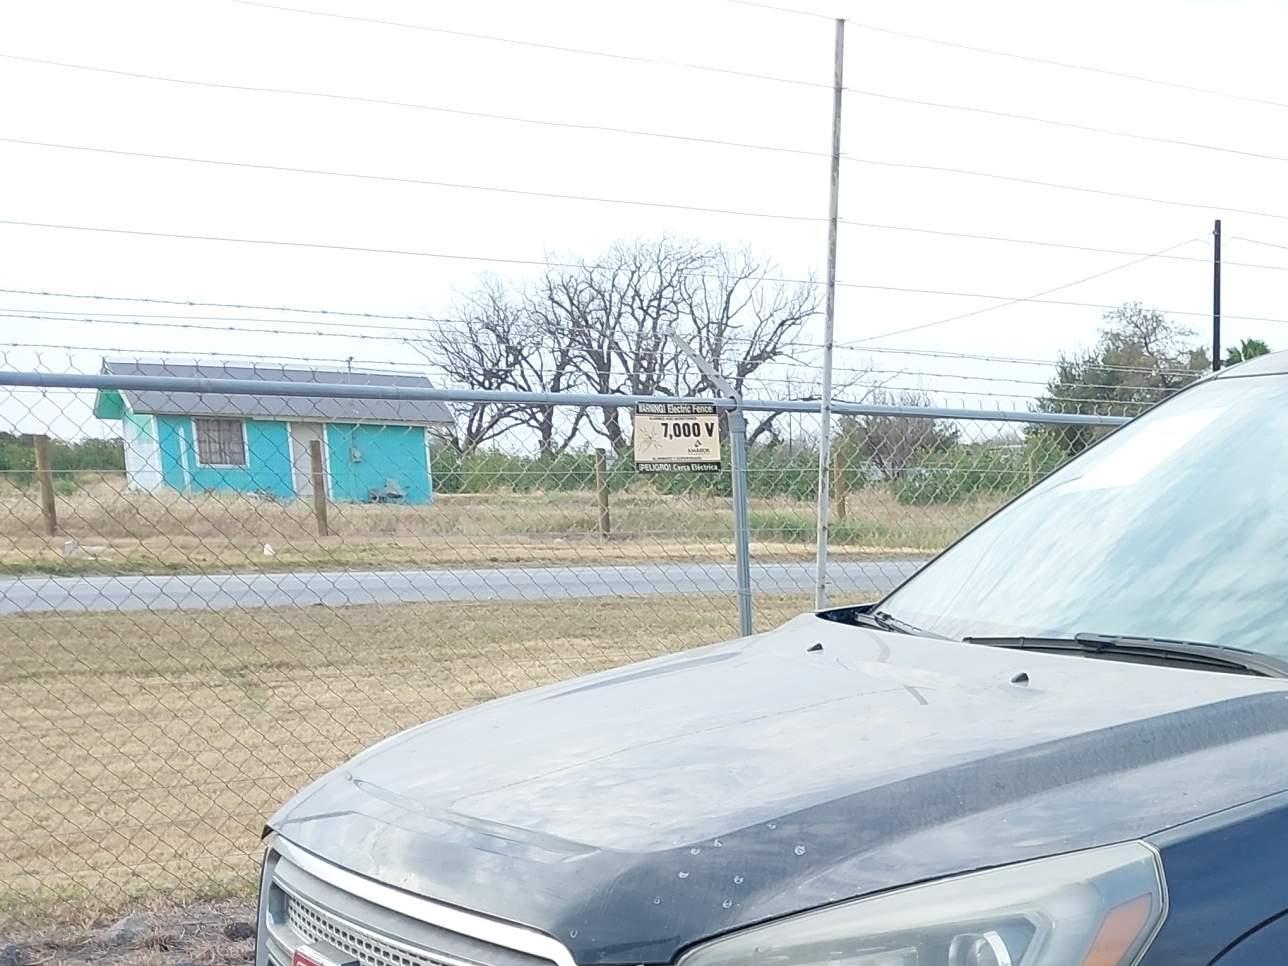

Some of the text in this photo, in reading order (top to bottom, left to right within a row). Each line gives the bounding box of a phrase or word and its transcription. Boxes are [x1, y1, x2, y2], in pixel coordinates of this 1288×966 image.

[668, 403, 691, 413] Electric
[693, 404, 713, 413] Fence
[661, 423, 714, 440] 7,000 V
